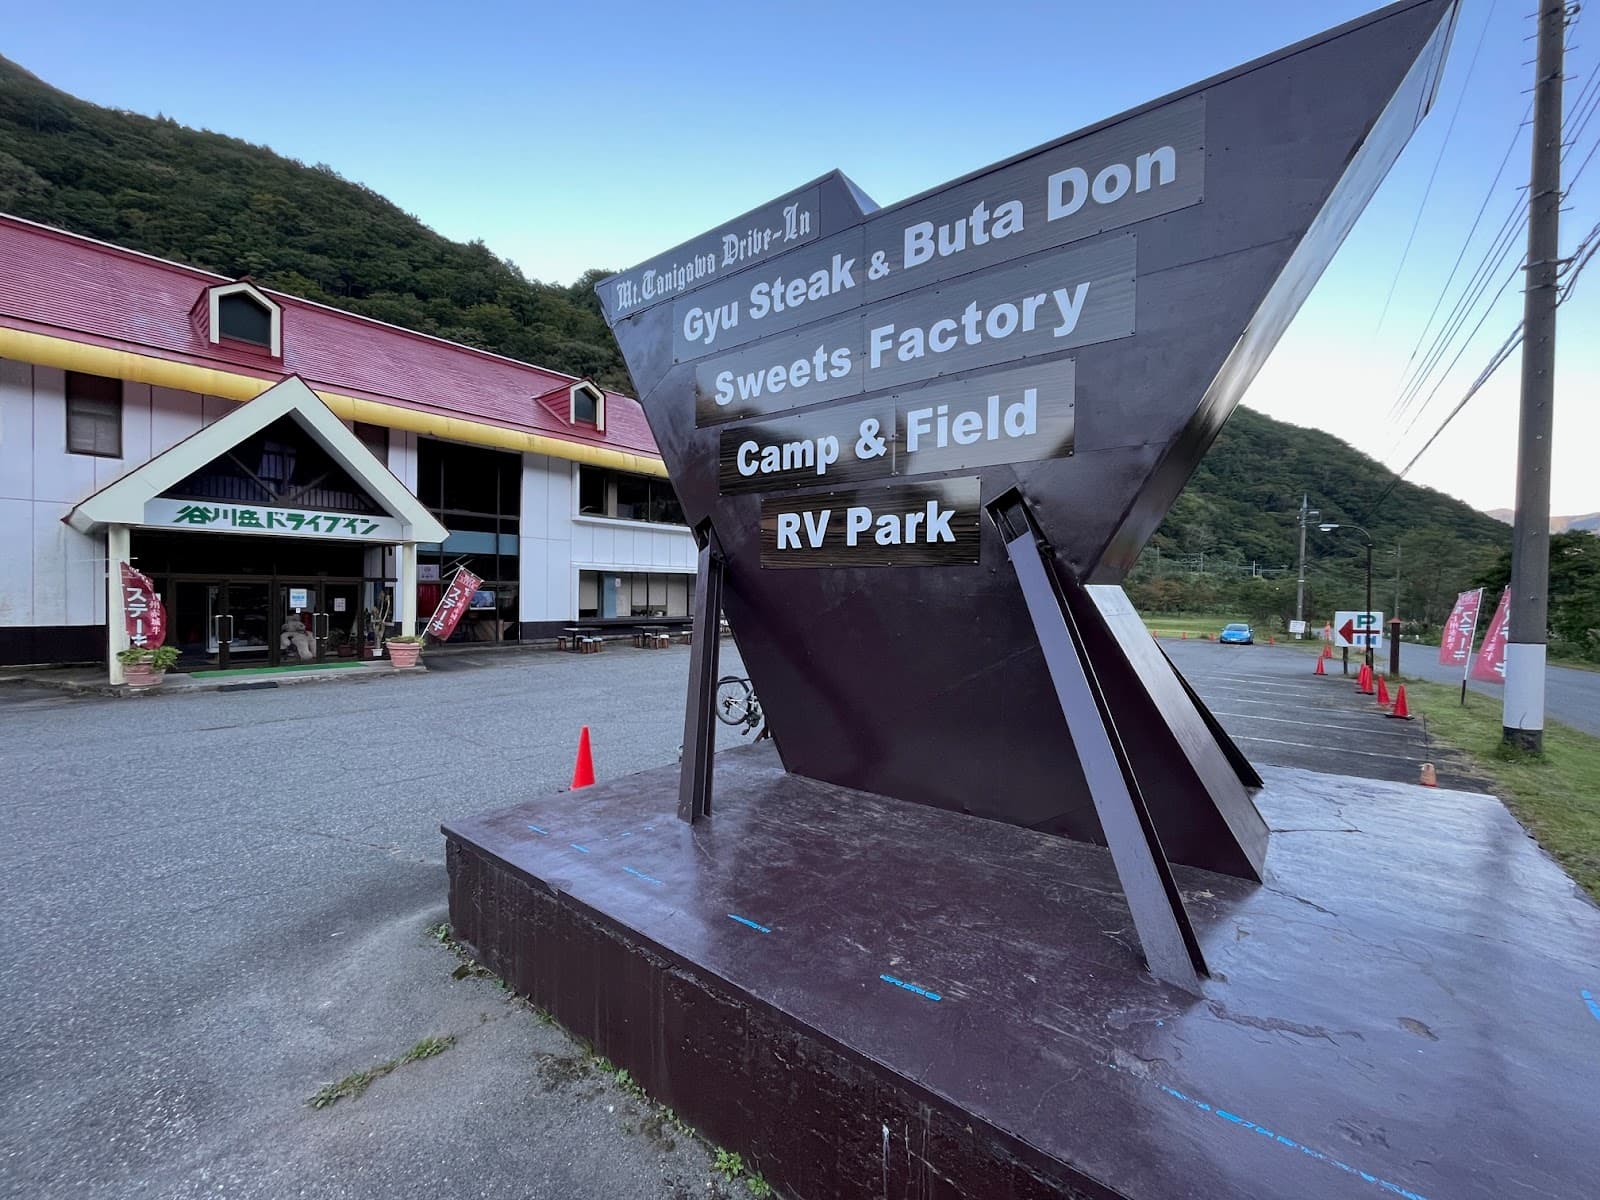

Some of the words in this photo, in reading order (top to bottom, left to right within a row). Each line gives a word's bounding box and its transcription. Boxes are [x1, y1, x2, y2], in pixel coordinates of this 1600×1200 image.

[683, 301, 739, 345] Gyu
[749, 253, 856, 320] Steak
[868, 250, 890, 280] &
[903, 200, 1025, 269] Buta
[1047, 145, 1176, 222] Don
[721, 202, 811, 268] Drive-In
[714, 344, 852, 406] Sweets
[870, 281, 1091, 369] Factory
[736, 435, 840, 476] Camp
[854, 418, 888, 460] &
[906, 388, 1038, 453] Field
[173, 505, 380, 535] 谷川岳ドライブイン
[776, 509, 832, 550] RV
[846, 500, 957, 547] Park
[126, 587, 148, 647] ステーキ
[432, 586, 462, 632] ステーキ
[1356, 614, 1377, 629] P
